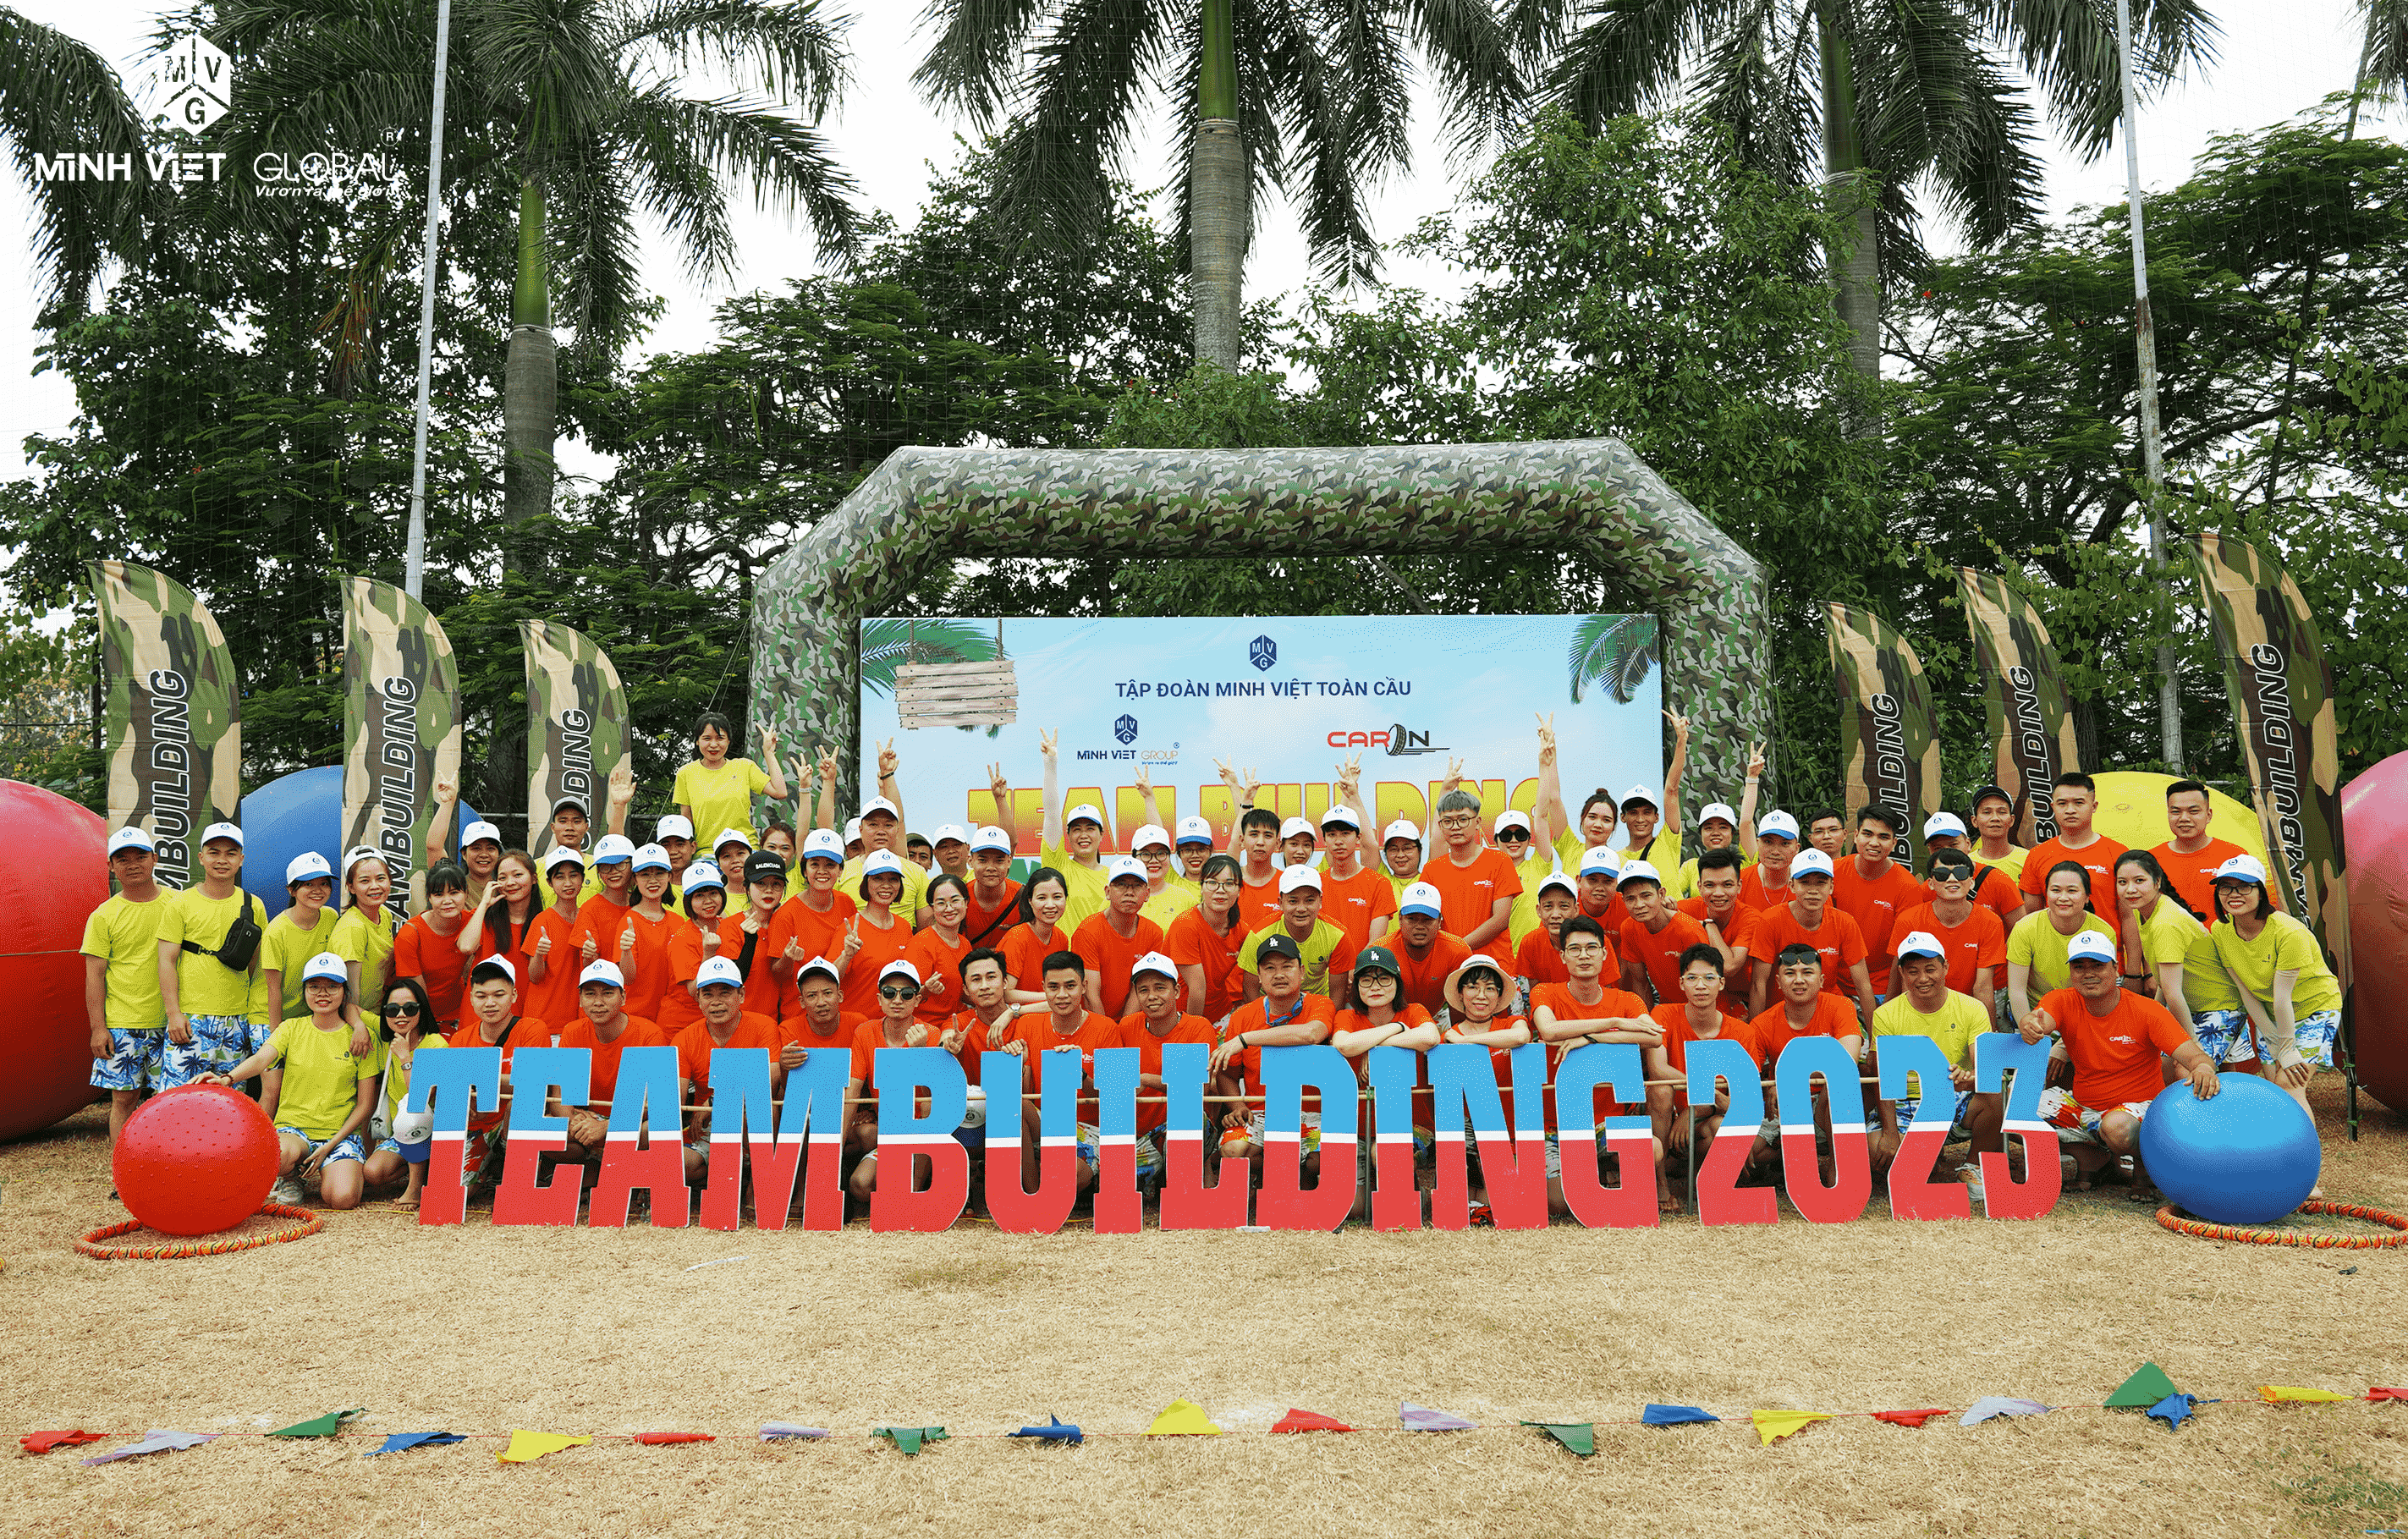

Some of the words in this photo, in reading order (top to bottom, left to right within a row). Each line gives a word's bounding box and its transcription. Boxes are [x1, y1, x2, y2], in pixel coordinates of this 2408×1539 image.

[1115, 679, 1152, 701] TẬP
[1156, 679, 1210, 697] ĐOÀN
[1216, 681, 1265, 697] MINH
[1271, 678, 1312, 700] VIỆT
[1317, 678, 1368, 696] TOÀN
[1374, 676, 1411, 696] CẦU
[1077, 750, 1108, 760] MINH
[1141, 750, 1179, 761] GROUP
[1269, 937, 1278, 947] LA
[1371, 950, 1380, 961] LA
[1684, 1031, 2063, 1227] 2023
